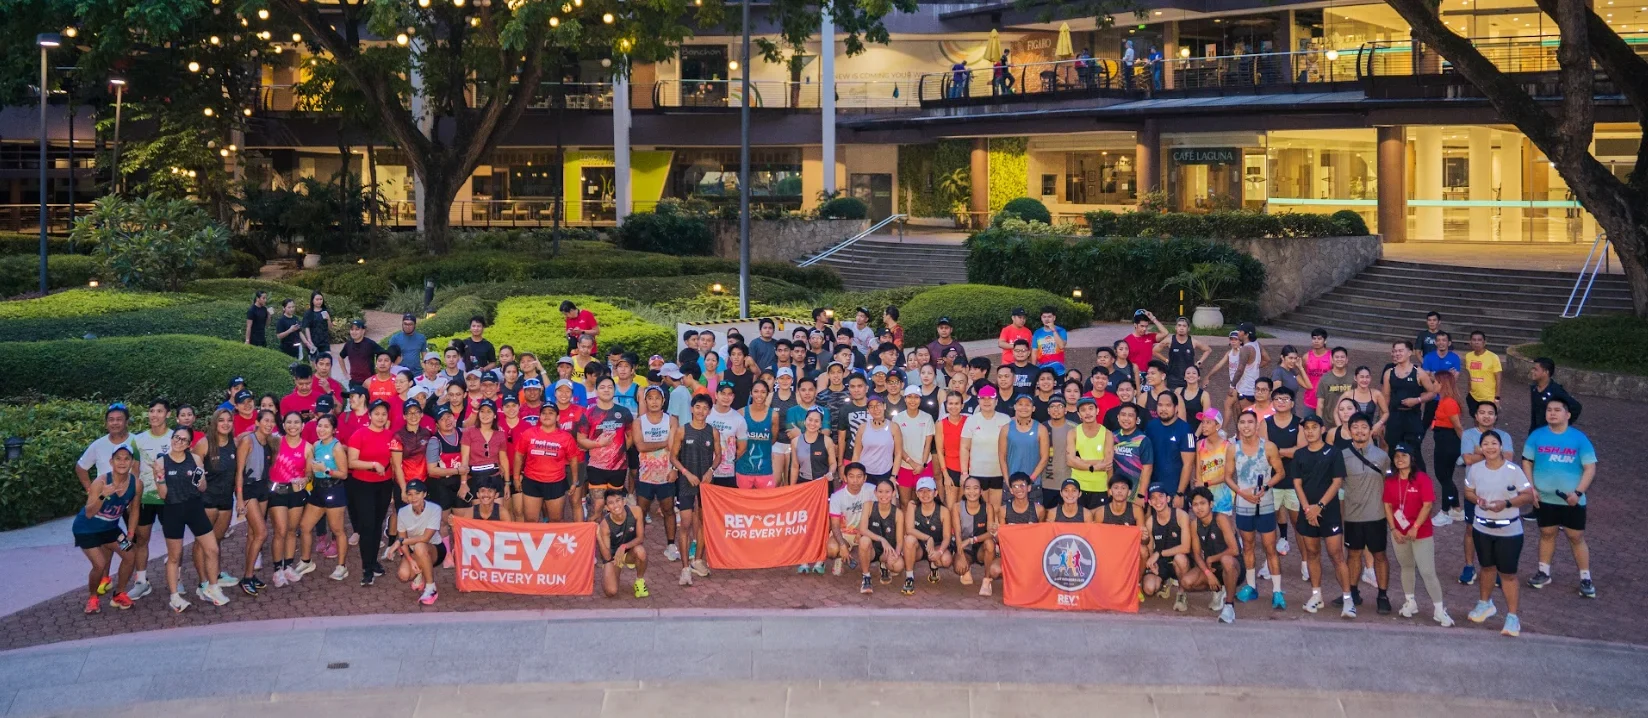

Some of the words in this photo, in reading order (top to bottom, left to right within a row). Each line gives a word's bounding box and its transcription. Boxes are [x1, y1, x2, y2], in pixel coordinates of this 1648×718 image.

[1027, 38, 1052, 50] FIGARO
[681, 46, 721, 56] Bonchon
[860, 72, 890, 80] COMING
[1173, 150, 1195, 161] CAFÉ
[1197, 151, 1233, 161] LAGUNA
[747, 431, 770, 439] ASIAN
[1549, 454, 1575, 463] RUN
[724, 513, 755, 528] REV
[763, 510, 808, 527] CLUB
[725, 529, 747, 539] FOR
[749, 527, 782, 539] EVERY
[785, 525, 807, 536] RUN
[461, 527, 556, 571] REV
[461, 568, 487, 580] FOR
[491, 571, 532, 584] EVERY
[537, 574, 566, 585] RUN
[1057, 593, 1076, 605] REV
